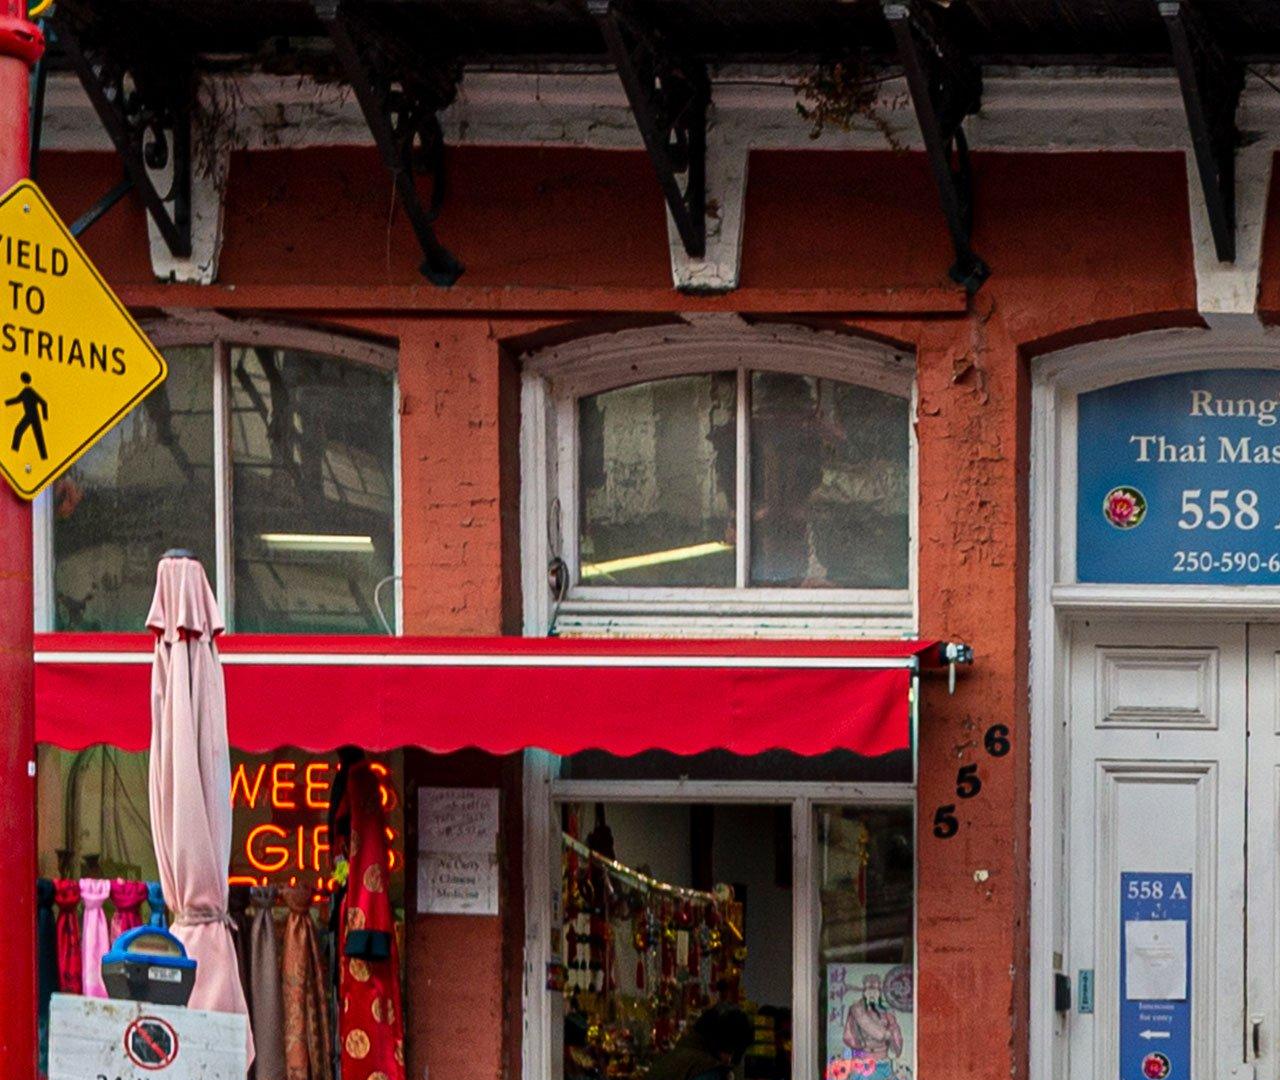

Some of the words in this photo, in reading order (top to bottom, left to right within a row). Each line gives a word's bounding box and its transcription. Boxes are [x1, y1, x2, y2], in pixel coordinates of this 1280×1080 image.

[0, 234, 69, 277] IELD
[8, 280, 45, 315] TO
[1129, 435, 1207, 463] Thai
[1177, 489, 1260, 530] 558
[1128, 881, 1164, 900] 558
[1169, 881, 1187, 900] A
